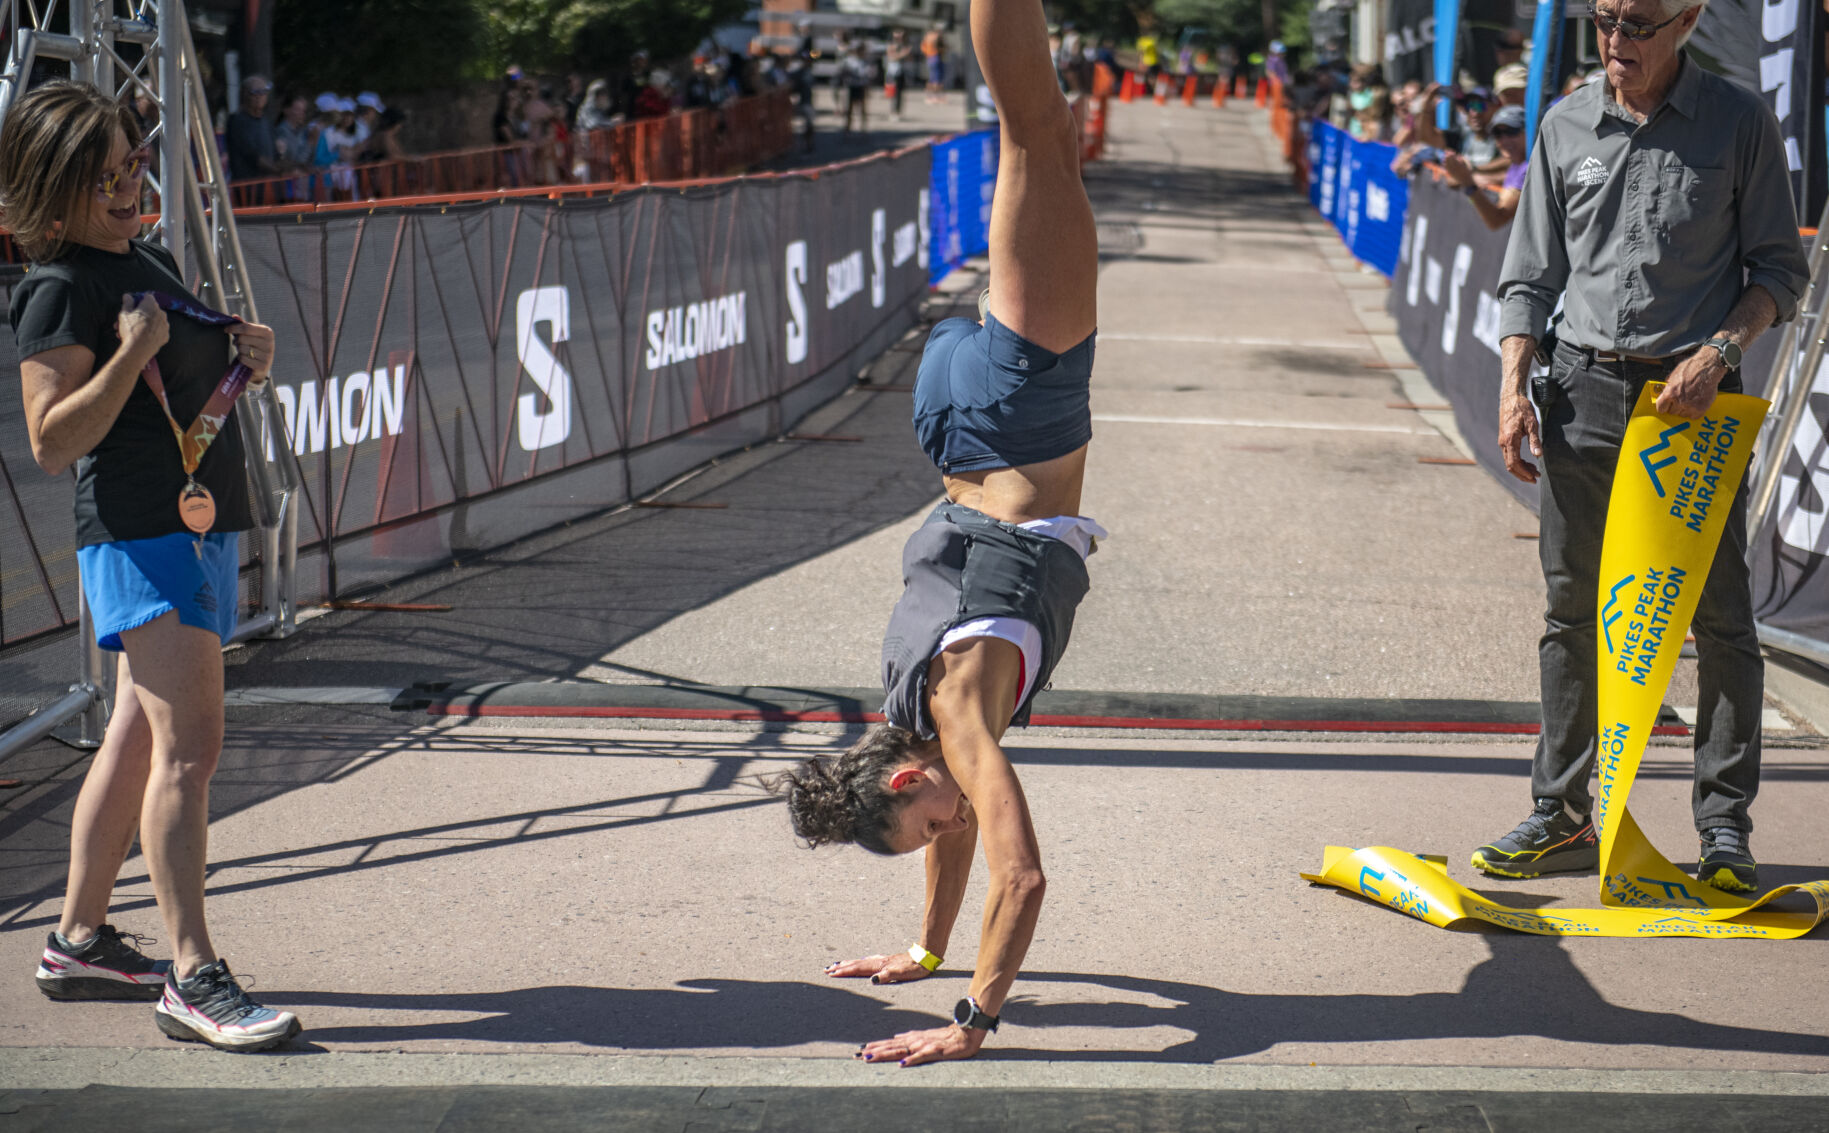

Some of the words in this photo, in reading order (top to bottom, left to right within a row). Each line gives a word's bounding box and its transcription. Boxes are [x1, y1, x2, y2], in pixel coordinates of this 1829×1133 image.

[646, 291, 747, 371] SALOMON
[786, 239, 808, 364] S
[262, 364, 405, 462] OMON
[516, 285, 571, 451] S
[1669, 467, 1699, 519] PIKES
[1688, 416, 1719, 465] PEAK
[1685, 416, 1741, 533] MARATHON
[1616, 620, 1644, 673] PIKES
[1633, 567, 1664, 617] PEAK
[1630, 566, 1687, 686] MARATHON
